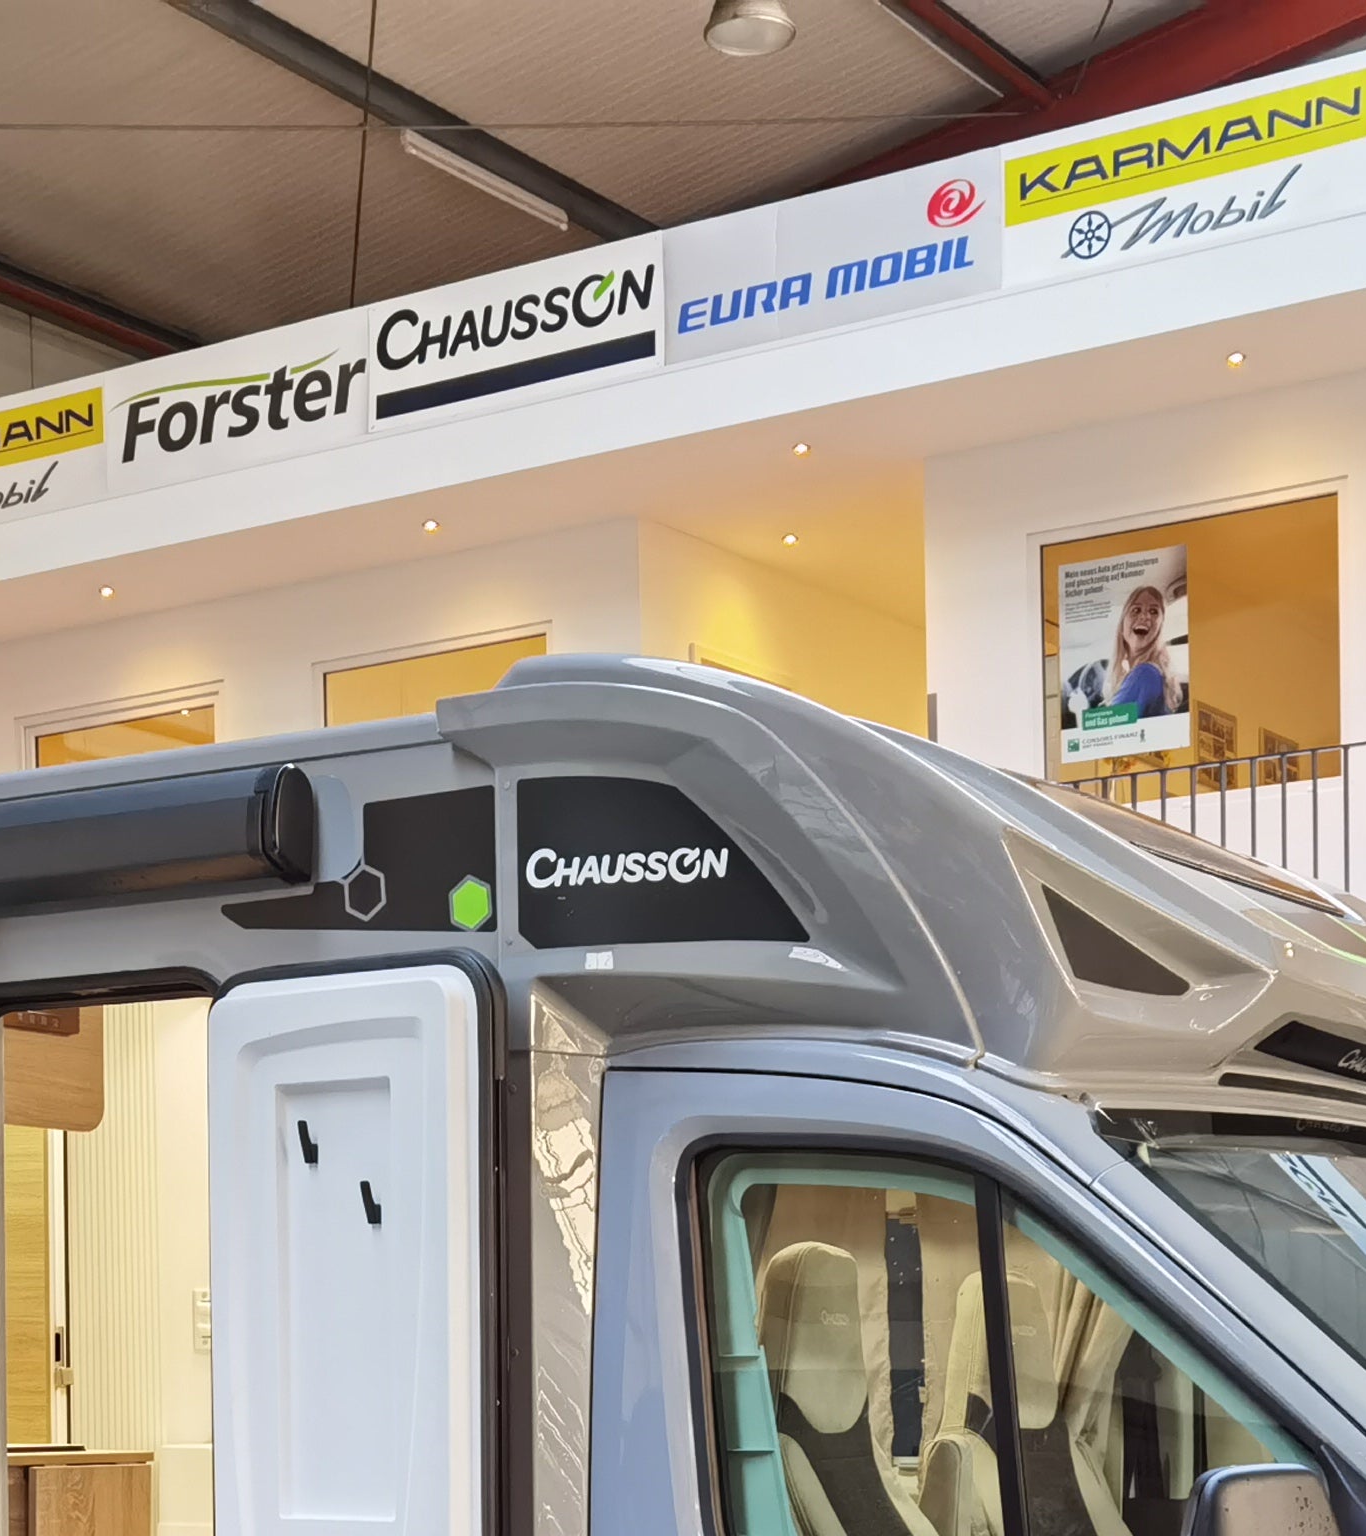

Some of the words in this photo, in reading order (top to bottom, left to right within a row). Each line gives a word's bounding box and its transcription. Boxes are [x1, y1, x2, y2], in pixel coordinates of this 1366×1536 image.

[1017, 86, 1363, 202] KARMANN
[1116, 164, 1304, 252] Mobil
[376, 263, 656, 371] CHAUSSON
[677, 273, 813, 334] EURA
[824, 235, 977, 300] MOBIL
[121, 357, 368, 464] Forster
[525, 847, 729, 889] CHAUSSON
